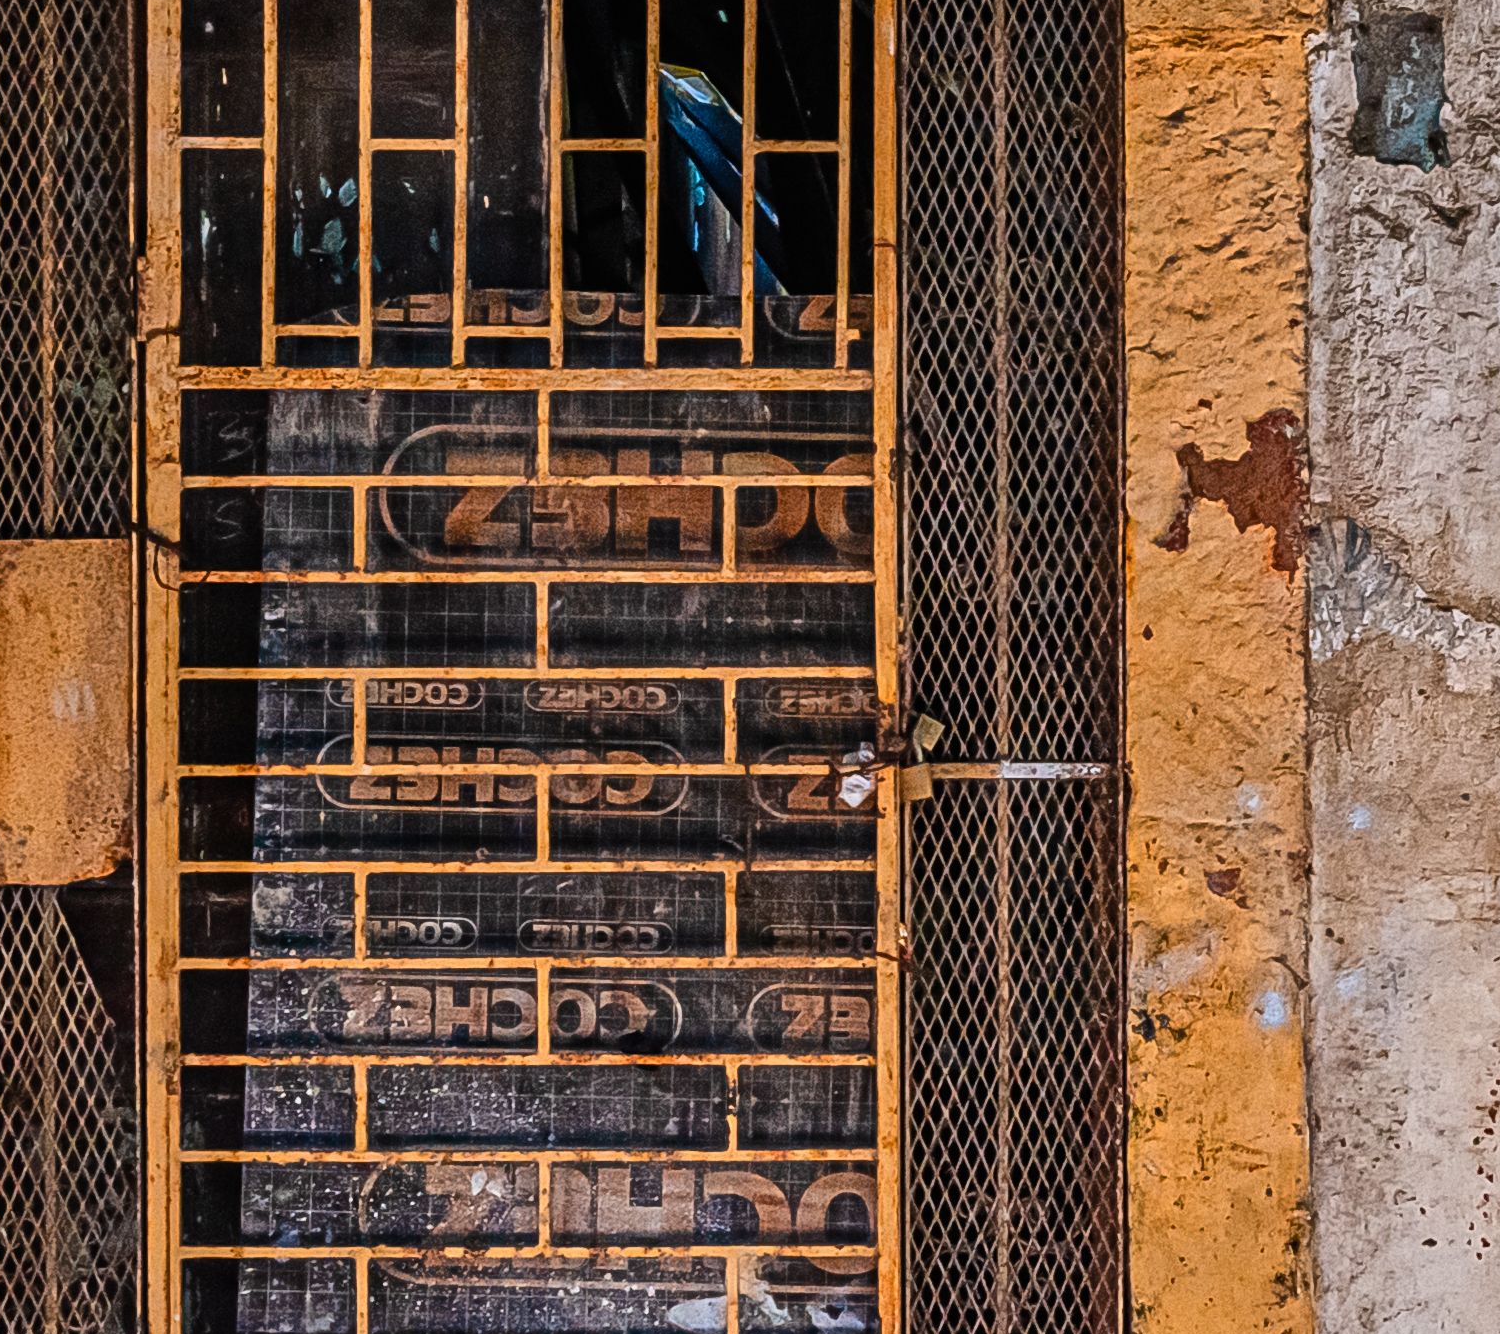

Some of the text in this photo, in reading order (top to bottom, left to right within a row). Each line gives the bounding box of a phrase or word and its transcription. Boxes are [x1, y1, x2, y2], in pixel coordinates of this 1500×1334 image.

[341, 680, 470, 706] COCHEZ
[538, 684, 668, 710] COCHEZ
[348, 746, 656, 805] COCHEZ
[342, 983, 656, 1042] COCHEZ
